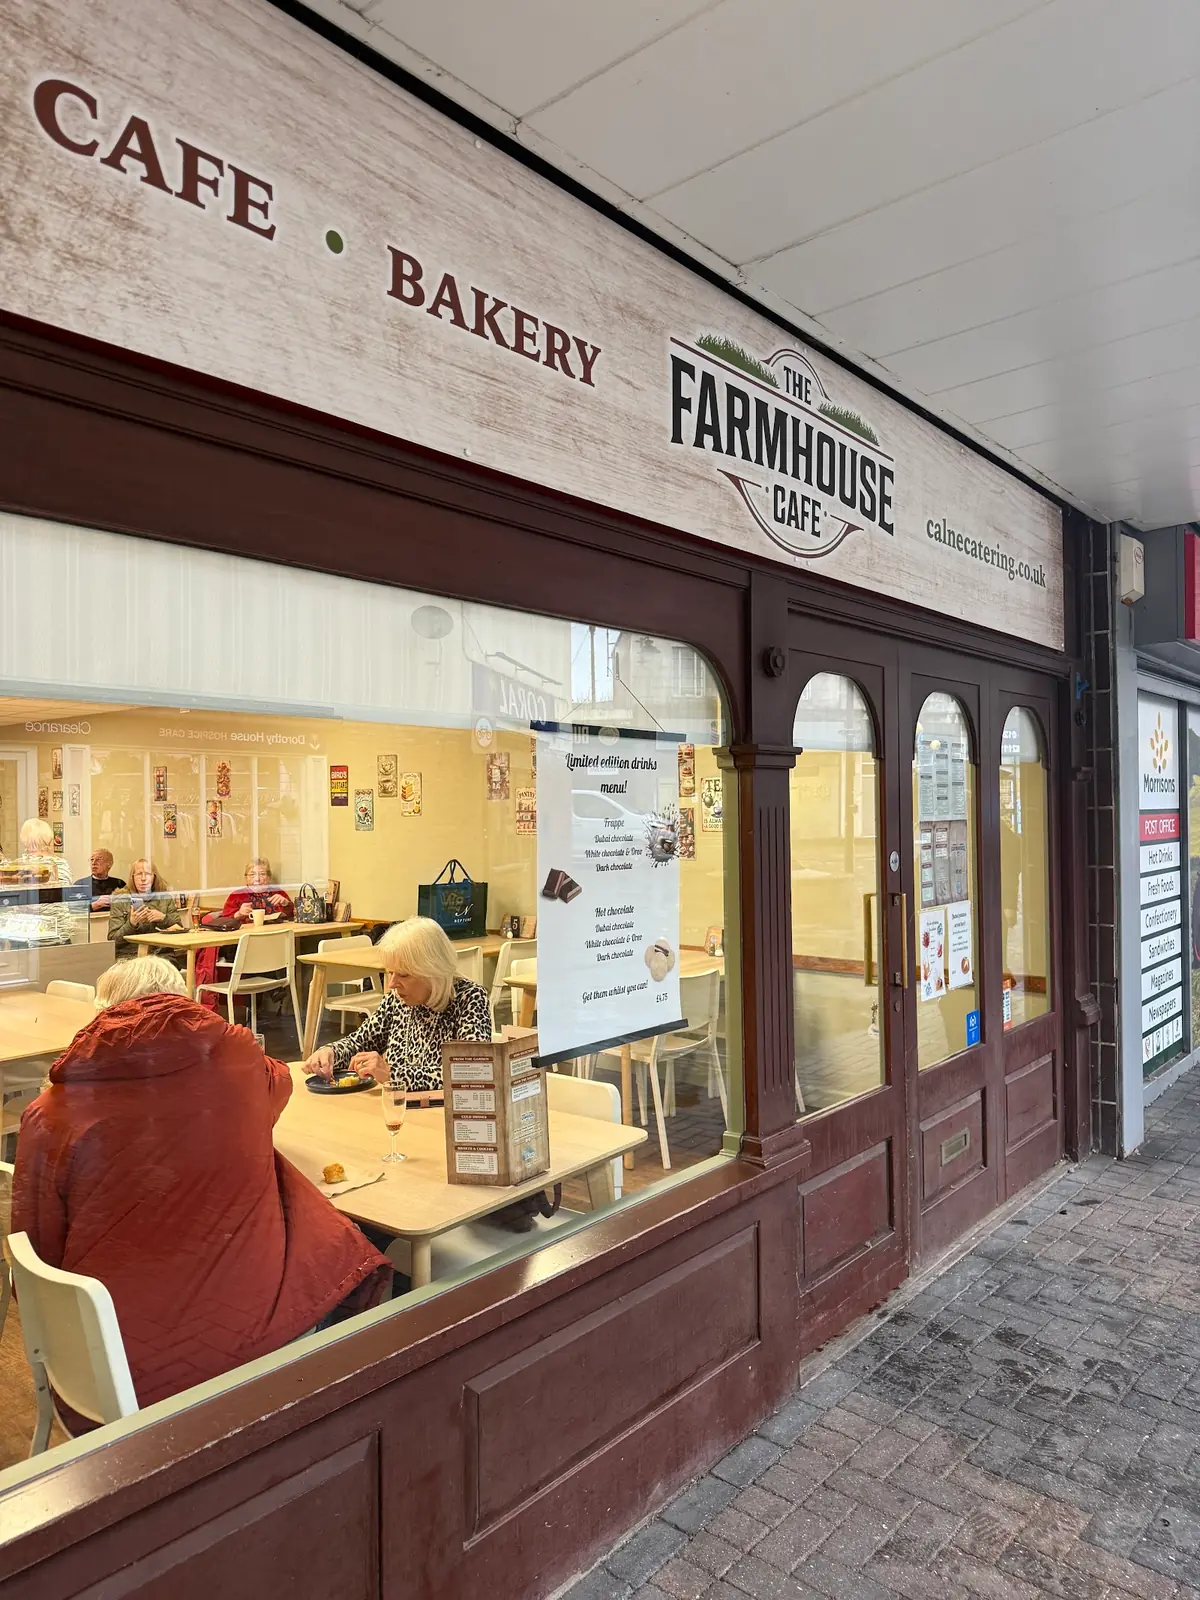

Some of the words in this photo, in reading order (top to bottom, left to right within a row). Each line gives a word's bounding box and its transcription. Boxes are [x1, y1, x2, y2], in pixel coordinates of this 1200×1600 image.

[33, 79, 276, 241] CAFE
[387, 245, 601, 387] BAKERY
[783, 365, 812, 406] THE
[670, 354, 894, 536] FARMHOUSE
[773, 484, 821, 538] CAFE
[926, 518, 1046, 588] calnecatering.co.uk
[565, 752, 600, 772] Limited
[600, 755, 630, 770] edition
[631, 756, 658, 771] drinks
[600, 779, 628, 794] menu!
[1143, 773, 1176, 793] Morrisons
[1144, 820, 1158, 835] POST
[1159, 818, 1176, 834] OFFICE
[594, 834, 611, 843] Dubai
[611, 834, 634, 843] chocolate
[584, 849, 601, 858] White
[601, 849, 625, 858] chocolate
[1148, 849, 1159, 866] Hot
[1159, 845, 1173, 864] Drinks
[595, 863, 610, 872] Dark
[610, 861, 633, 871] chocolate
[1147, 880, 1160, 897] Fresh
[1160, 878, 1175, 895] Foods
[594, 906, 607, 918] Hot
[606, 904, 634, 917] chocolate
[1145, 907, 1177, 929] Confectionery
[512, 918, 519, 930] 5
[594, 922, 611, 933] Dubai
[611, 920, 634, 931] chocolate
[584, 939, 601, 949] White
[602, 936, 626, 947] chocolate
[1148, 937, 1175, 960] Sandwiches
[596, 952, 611, 962] Dark
[611, 948, 634, 960] chocolate
[1150, 967, 1174, 991] Magazines
[582, 990, 593, 1004] Get
[593, 988, 608, 1001] them
[608, 984, 626, 997] whilst
[626, 983, 637, 996] you
[637, 979, 649, 991] can!
[1148, 995, 1176, 1023] Newspapers
